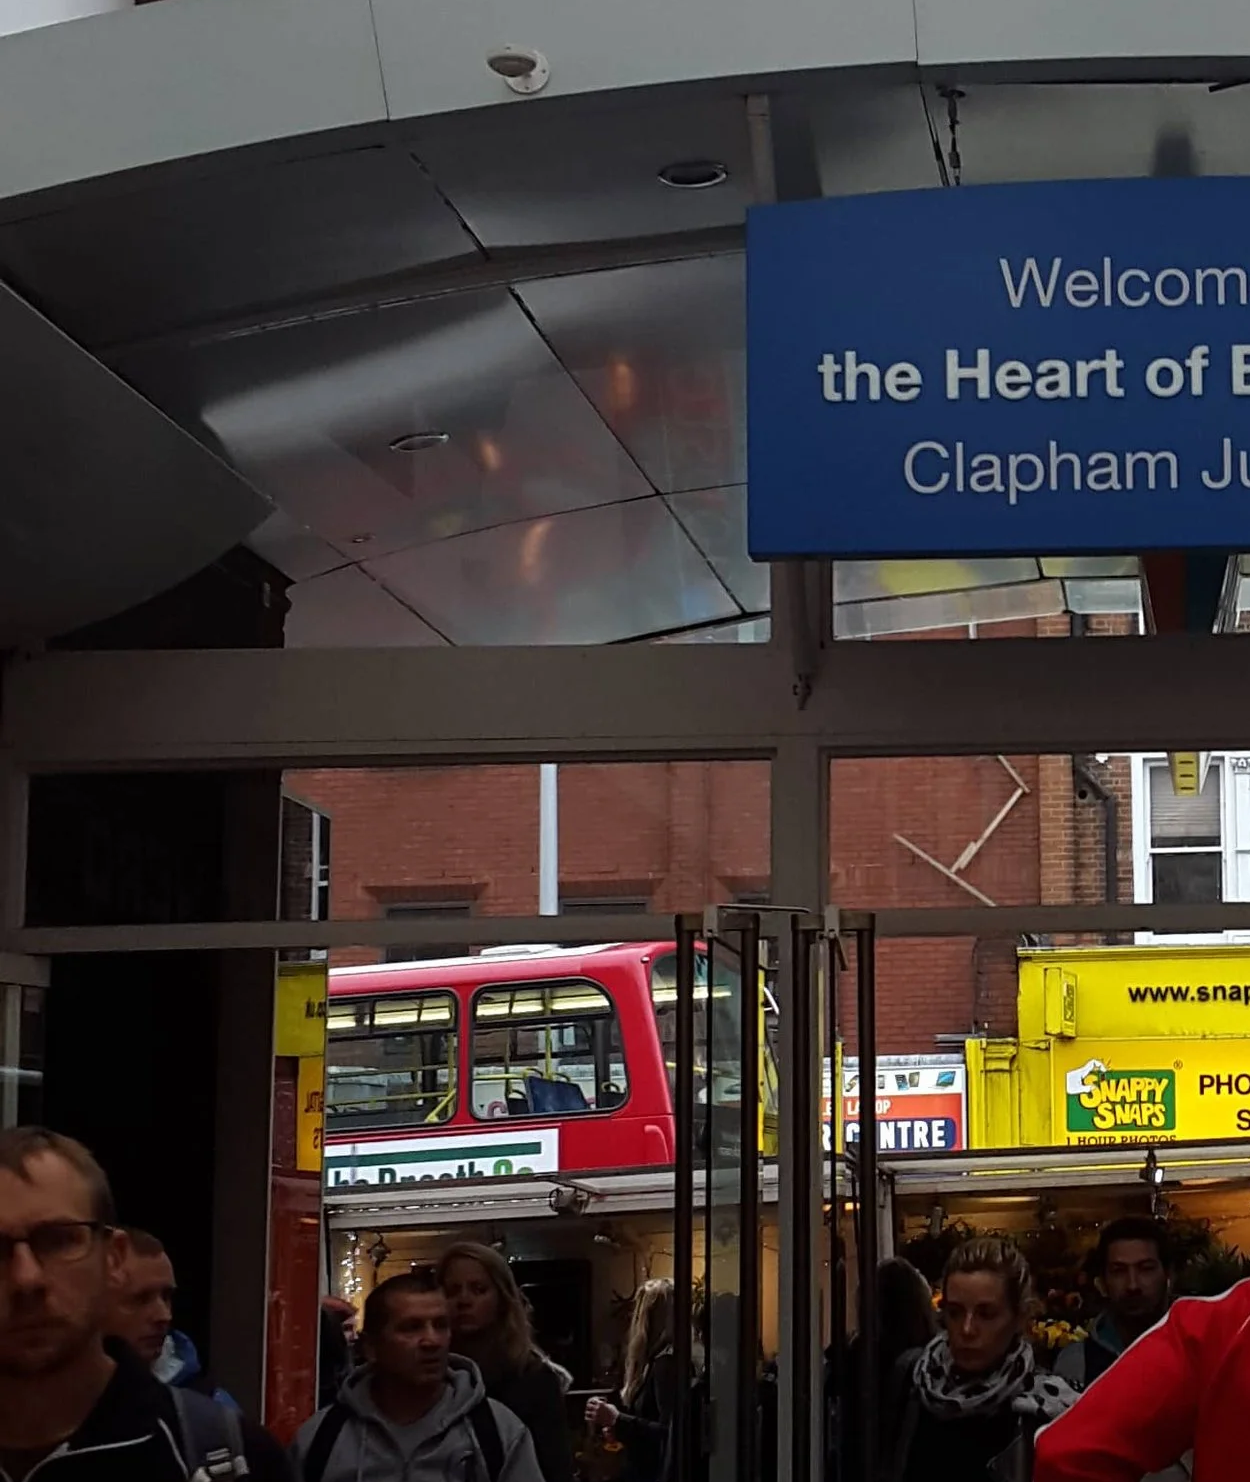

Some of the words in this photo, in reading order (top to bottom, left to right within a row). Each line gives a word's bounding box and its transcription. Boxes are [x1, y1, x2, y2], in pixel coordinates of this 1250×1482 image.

[817, 350, 923, 402] the
[944, 348, 1125, 399] Heart
[1145, 344, 1210, 397] of
[902, 440, 1179, 505] Clapham
[1080, 1074, 1169, 1109] SNAPPY
[1093, 1102, 1166, 1130] SNAPS
[846, 1120, 946, 1151] CNTRE
